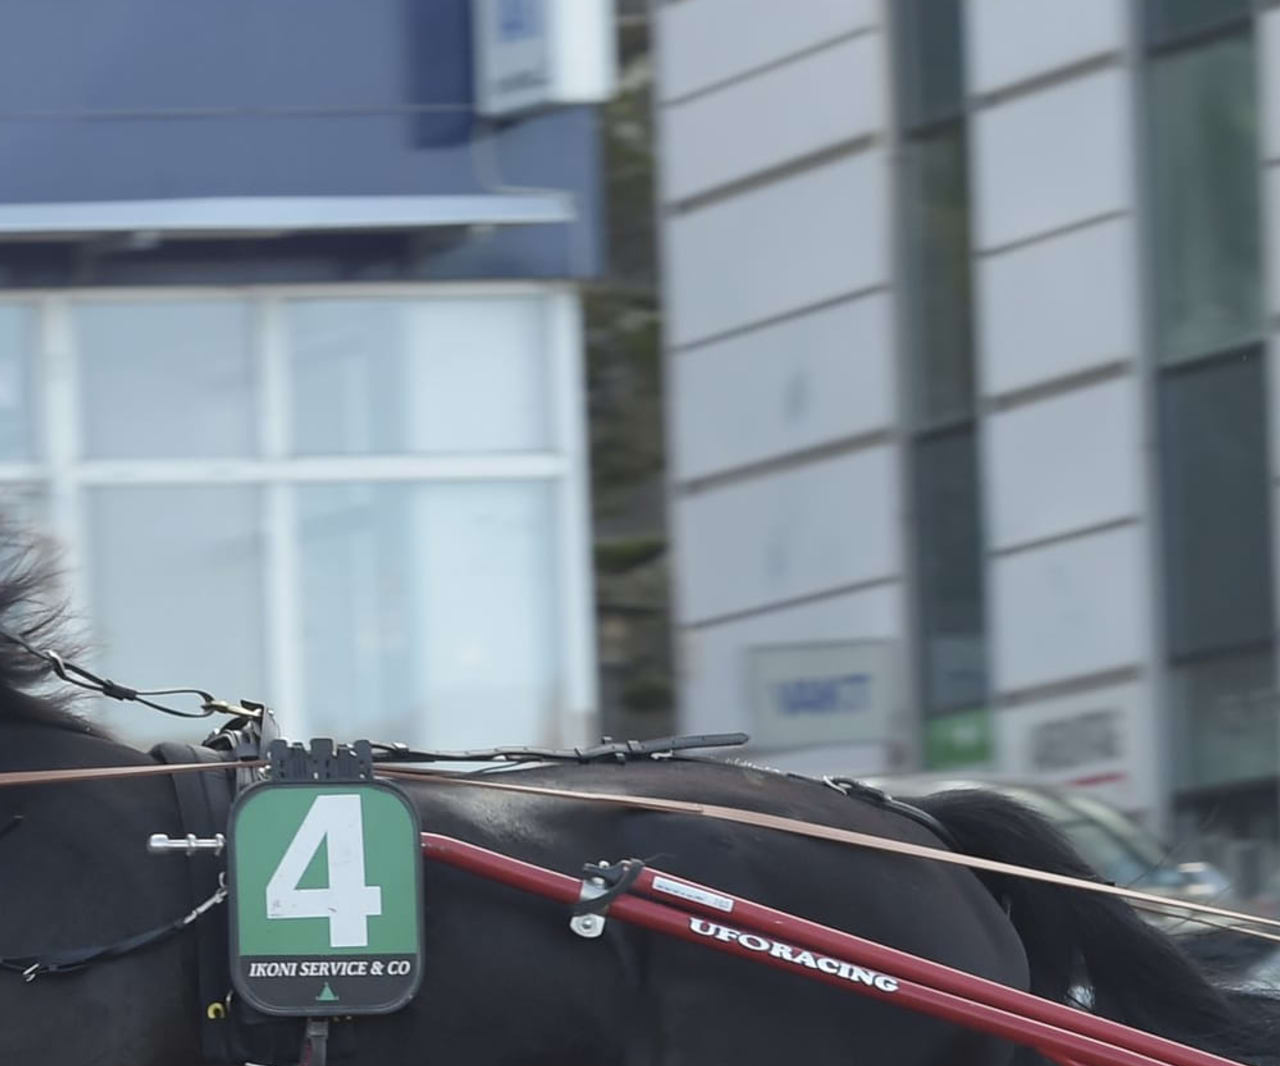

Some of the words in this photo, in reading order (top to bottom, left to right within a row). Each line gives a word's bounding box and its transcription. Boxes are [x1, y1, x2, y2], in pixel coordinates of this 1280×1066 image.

[266, 793, 382, 947] 4
[249, 962, 298, 977] IKONI
[299, 961, 368, 977] SERVICE
[370, 960, 385, 976] &
[387, 960, 411, 975] CO
[688, 916, 900, 992] UFORACING
